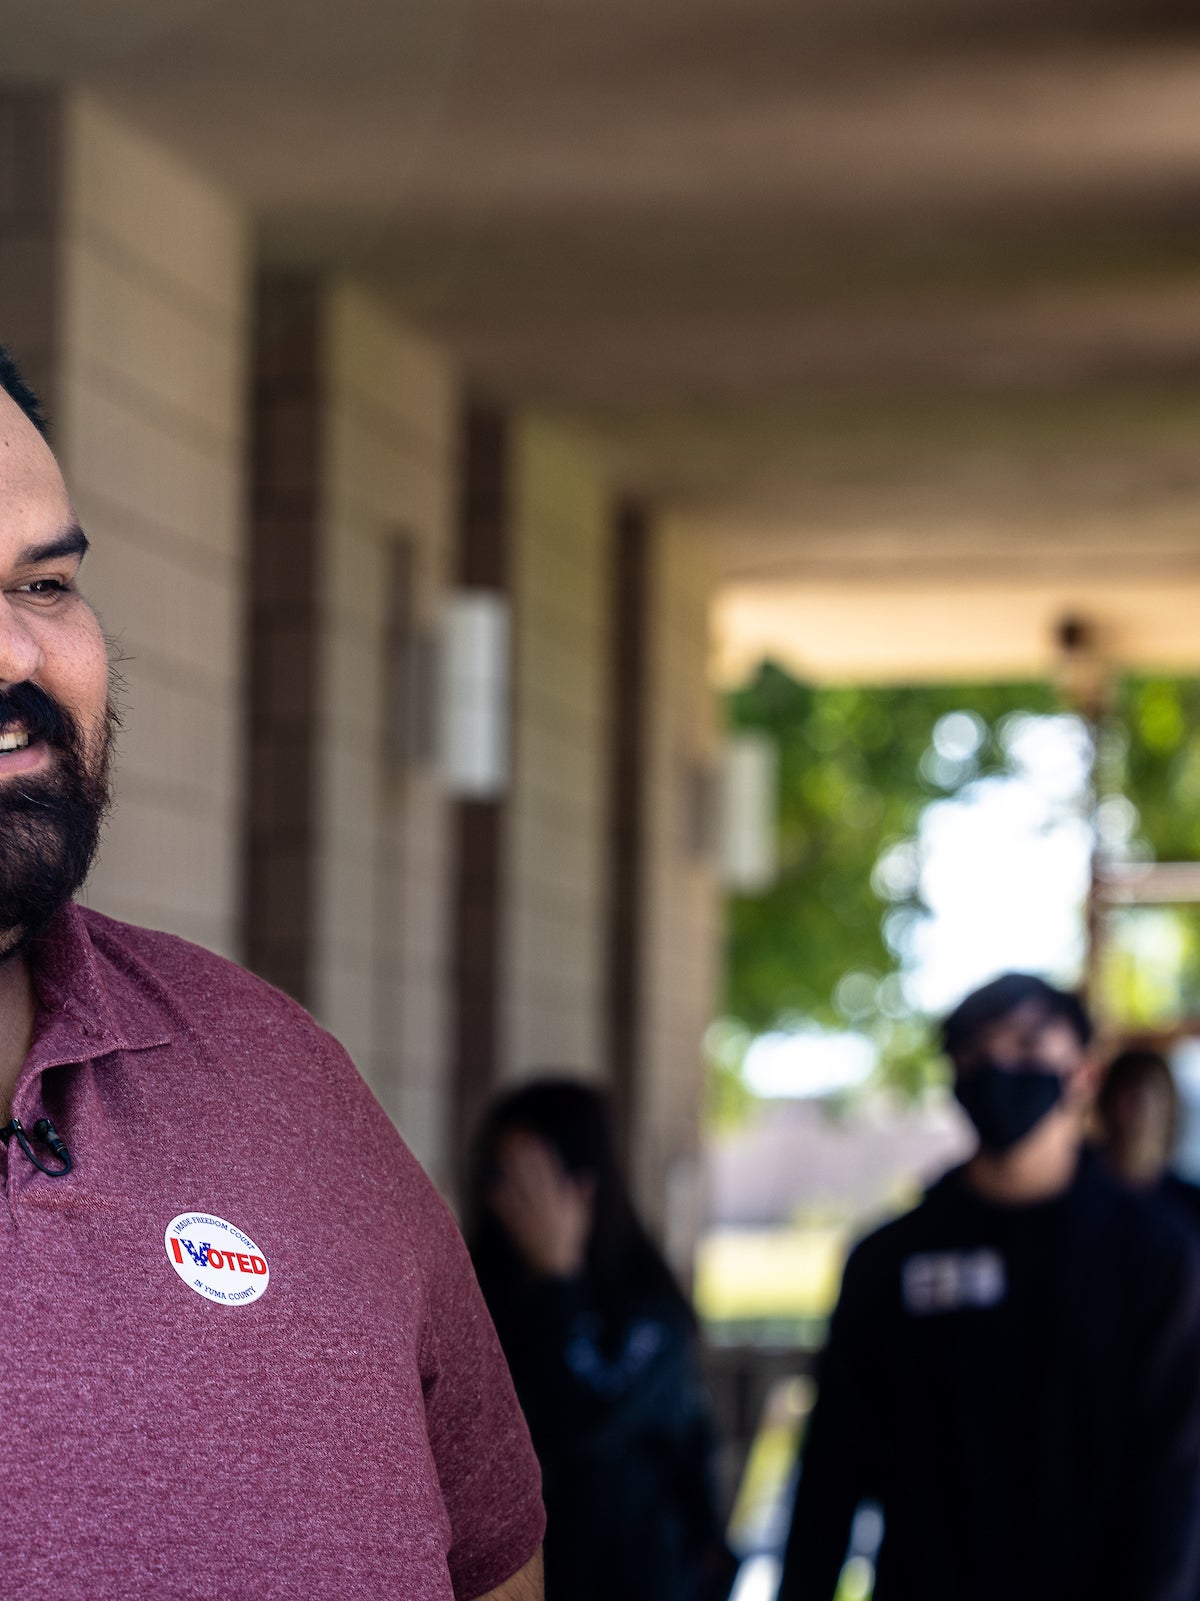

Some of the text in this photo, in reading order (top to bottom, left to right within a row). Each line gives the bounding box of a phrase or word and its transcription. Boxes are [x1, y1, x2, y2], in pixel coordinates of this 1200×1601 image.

[175, 1217, 193, 1232] MADE
[191, 1216, 228, 1231] FREEDOM
[229, 1228, 255, 1250] COUNT
[170, 1237, 267, 1275] I VOTED
[194, 1279, 256, 1301] IN YUMA COUNTY
